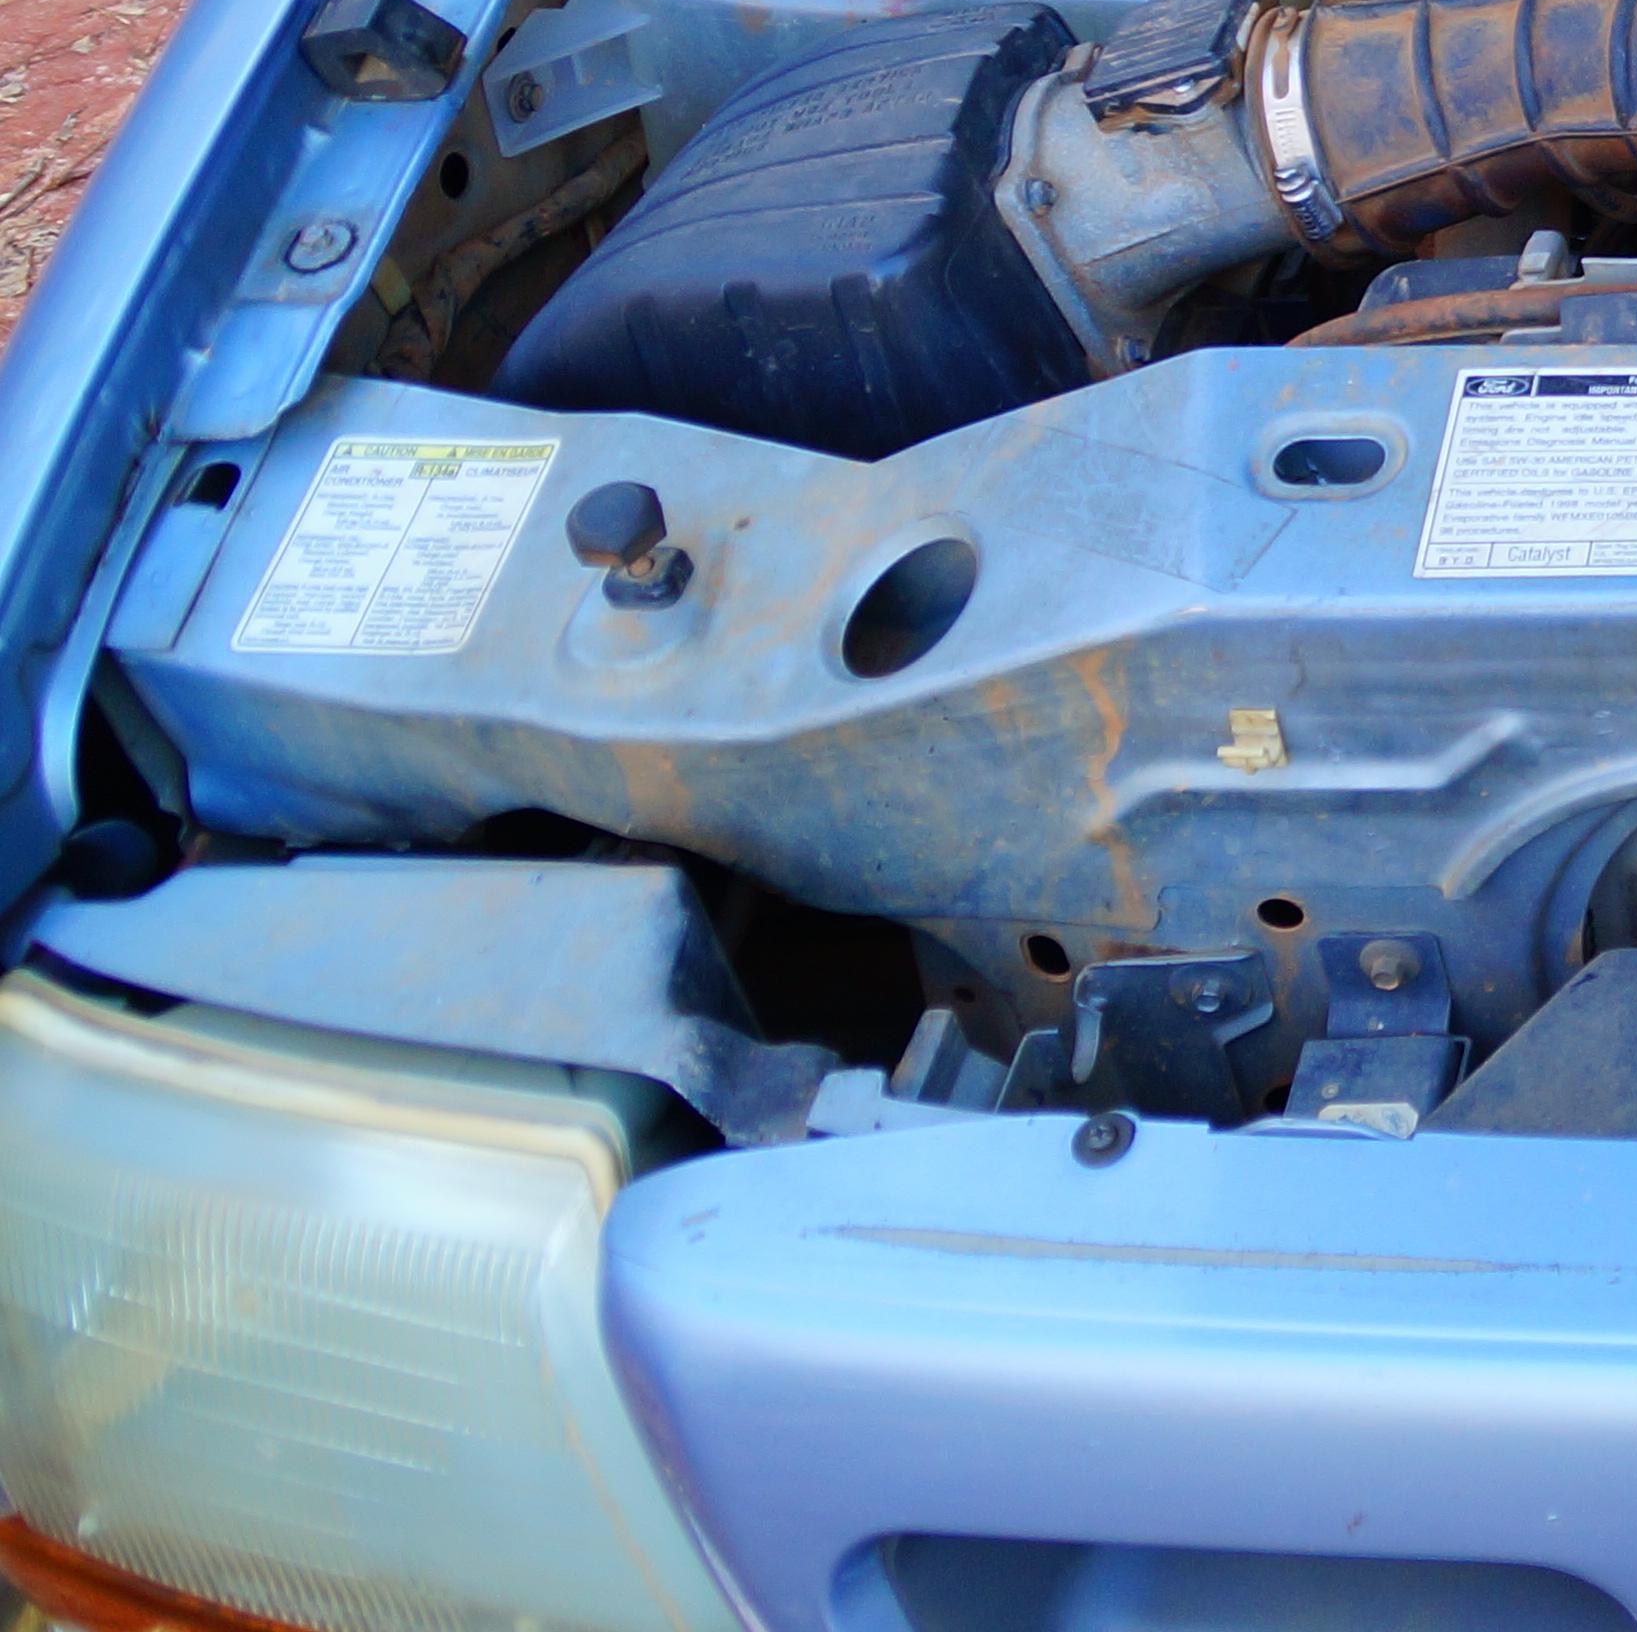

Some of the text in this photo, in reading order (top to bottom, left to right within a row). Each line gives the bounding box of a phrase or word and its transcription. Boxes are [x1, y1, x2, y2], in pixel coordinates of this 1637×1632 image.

[1477, 379, 1516, 393] Ford
[364, 448, 417, 457] CAUTION
[1505, 546, 1571, 566] Catalyst
